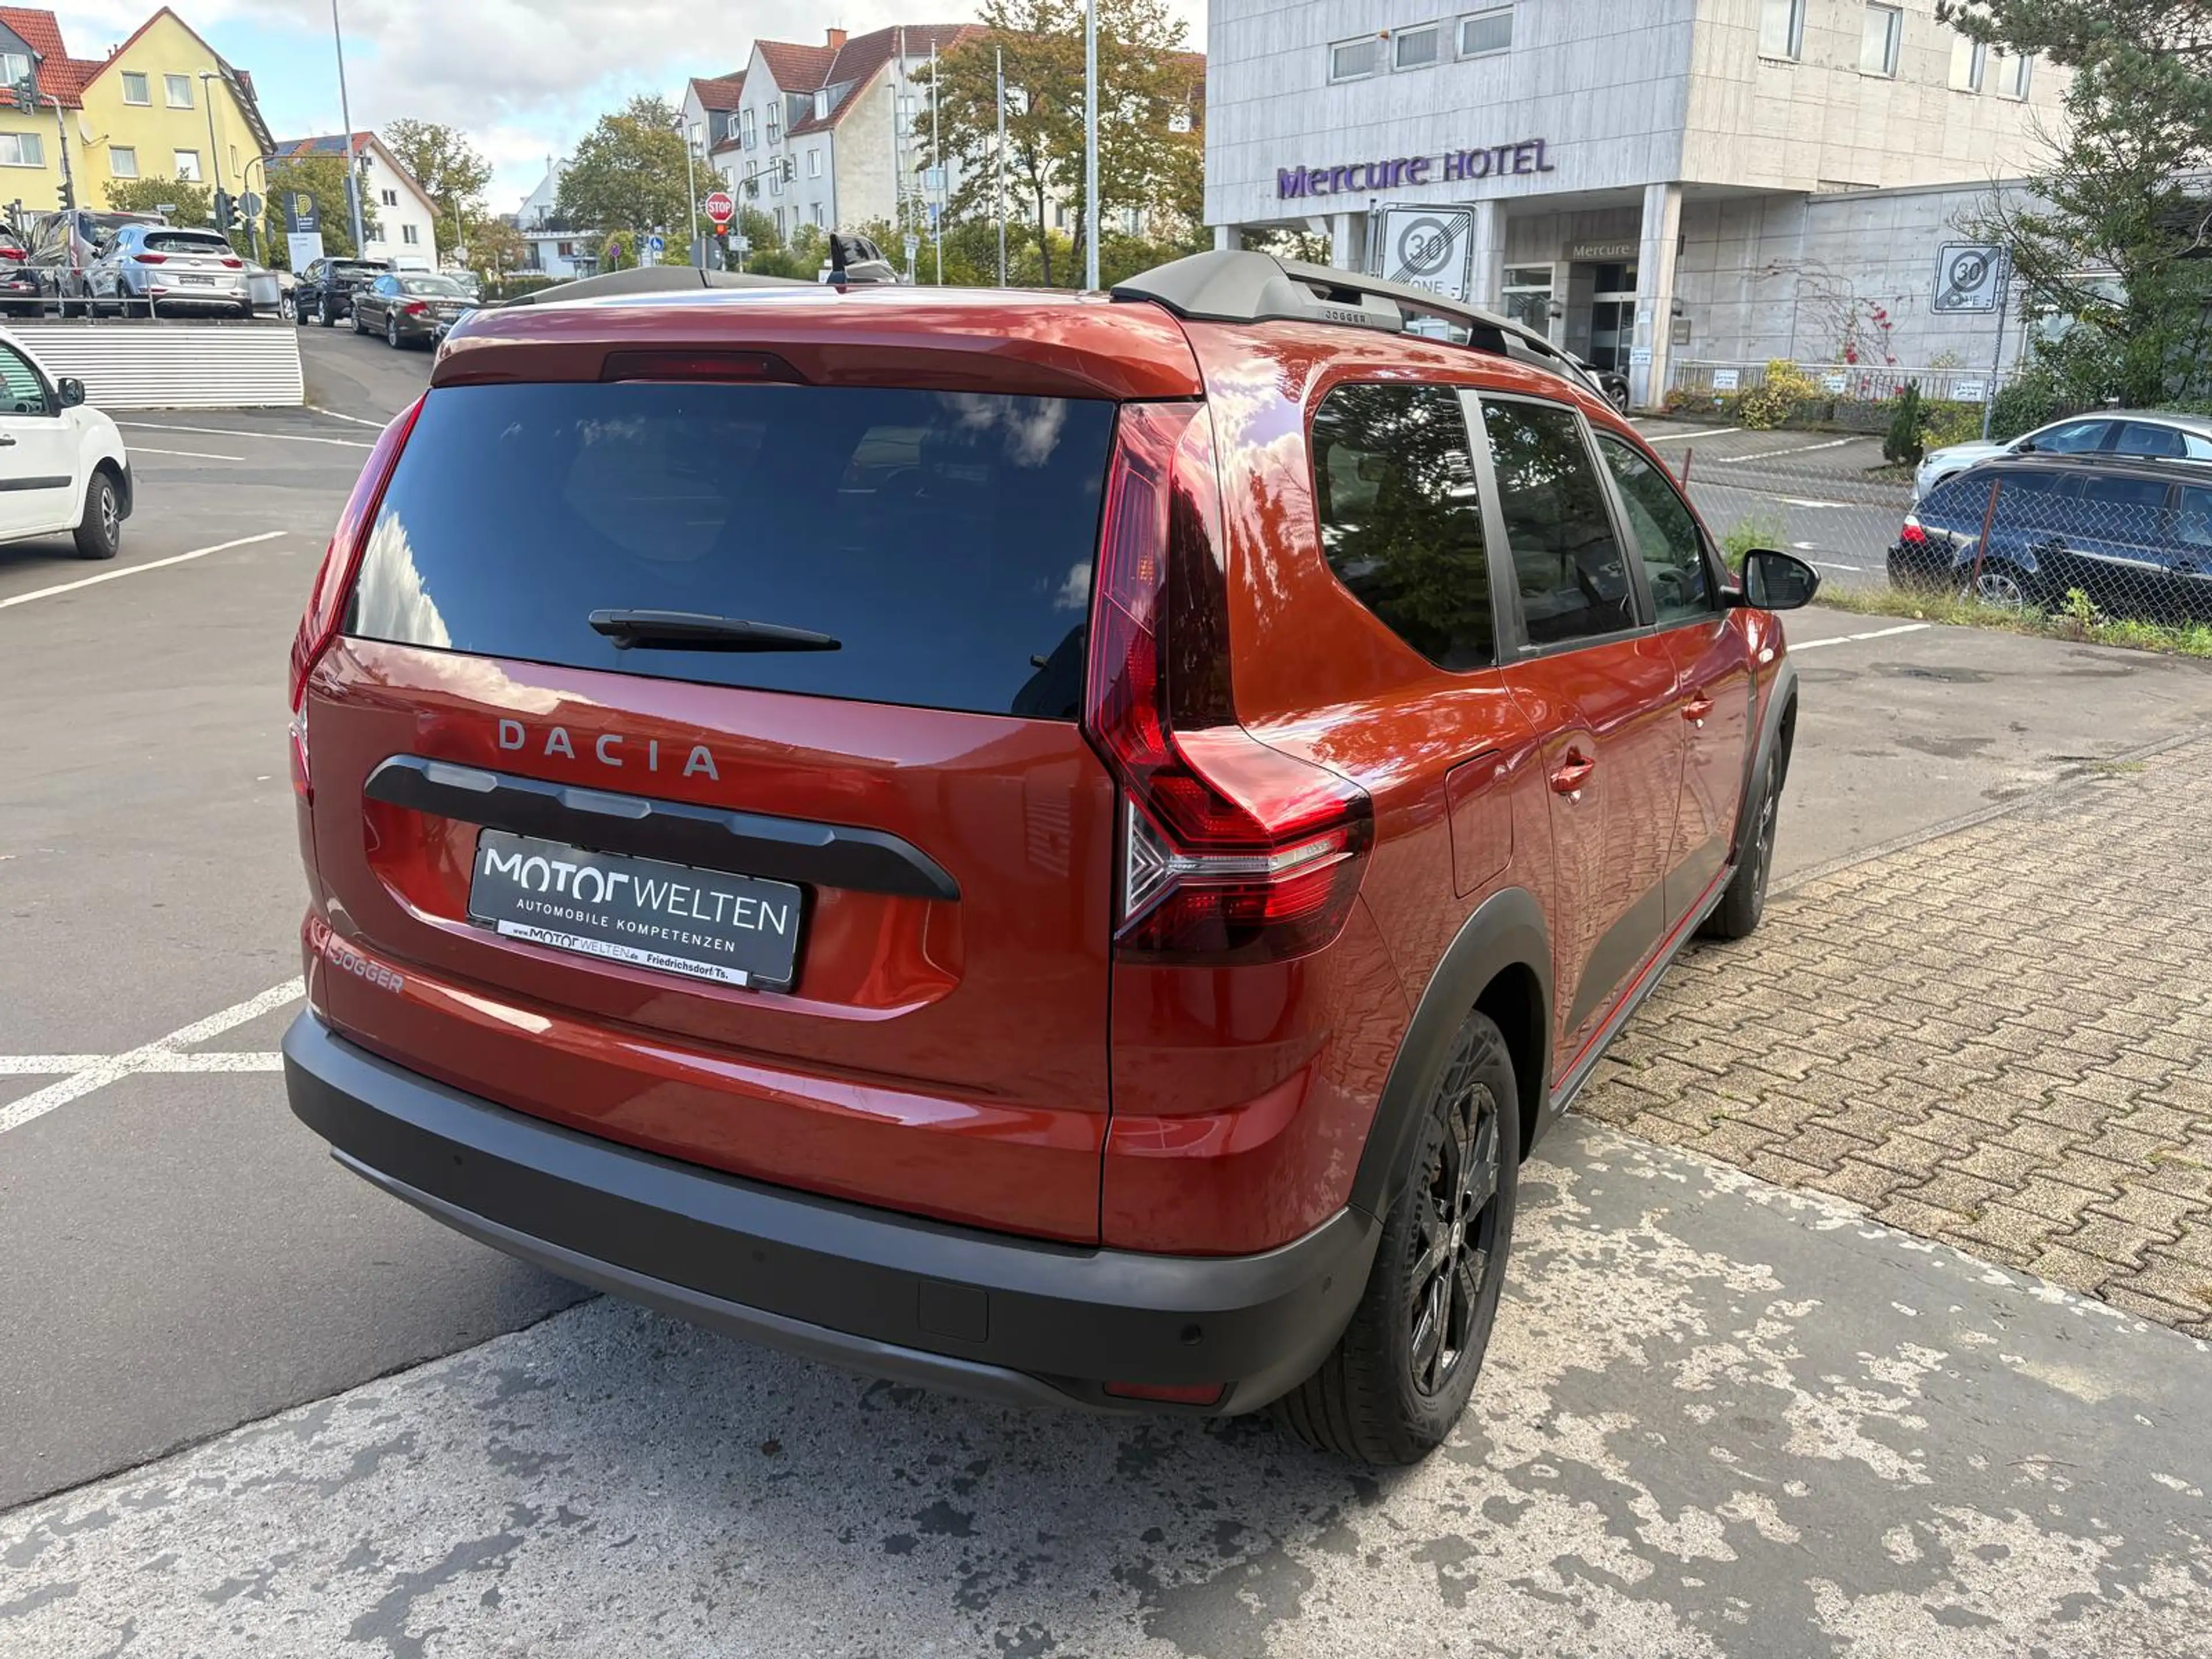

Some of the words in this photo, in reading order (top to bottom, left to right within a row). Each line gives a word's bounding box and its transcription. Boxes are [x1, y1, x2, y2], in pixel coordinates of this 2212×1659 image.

[1277, 155, 1430, 199] Mercure
[1444, 138, 1554, 181] HOTEL
[709, 201, 731, 214] STOP
[1409, 234, 1442, 261] 30
[1573, 244, 1630, 257] Mercure
[1957, 263, 1980, 281] 30
[1325, 310, 1366, 324] JOGGER
[498, 718, 719, 781] DACIA
[516, 898, 608, 927] AUTOMOBILE
[616, 919, 736, 952] KOMPETENZEN
[331, 947, 404, 994] JOGGER
[646, 953, 714, 976] Friedrichsdorf
